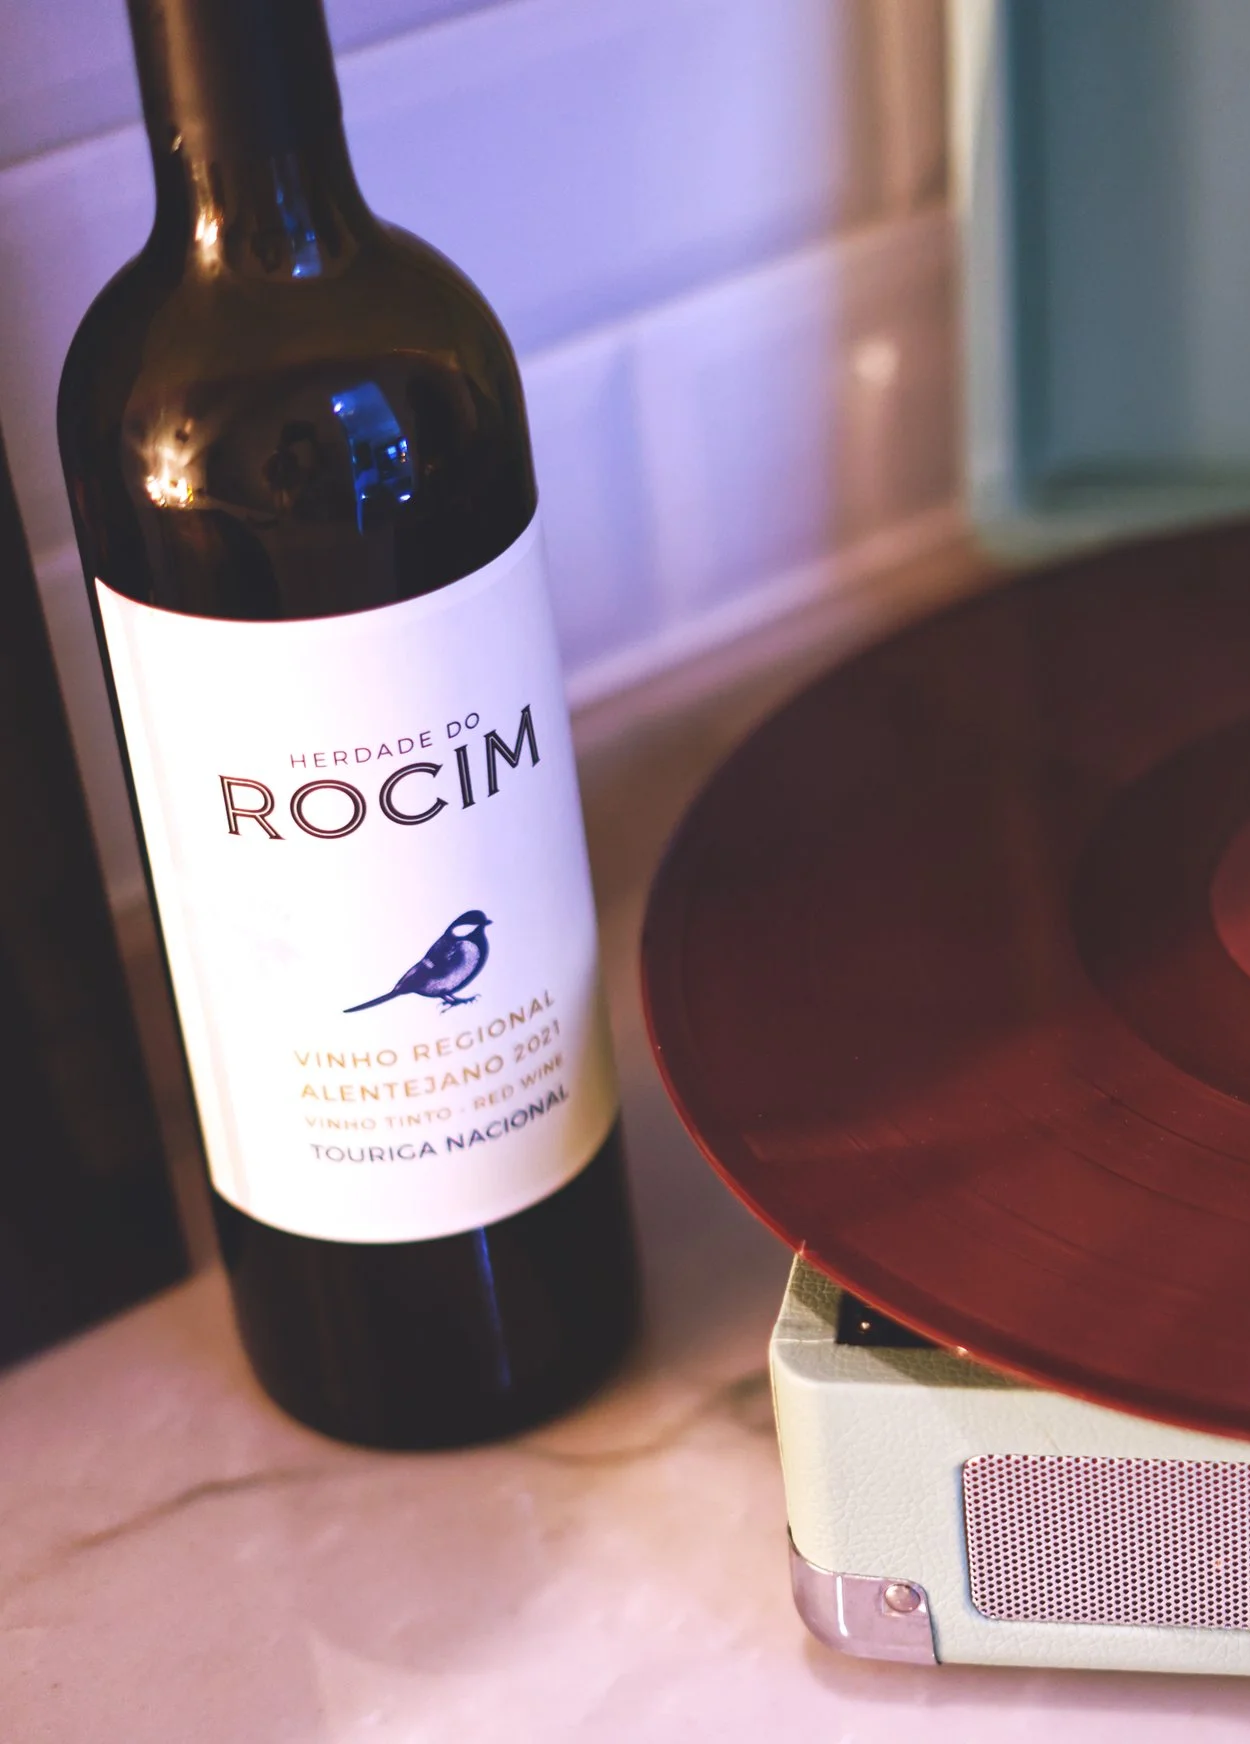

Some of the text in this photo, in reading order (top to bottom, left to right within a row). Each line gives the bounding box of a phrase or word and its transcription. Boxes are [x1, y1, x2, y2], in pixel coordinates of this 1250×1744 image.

[218, 704, 541, 840] ROCIM
[290, 712, 480, 768] HERDADE DO
[293, 990, 555, 1069] VINHO REGIONAL
[301, 1020, 561, 1102] ALENTEJANO 2021
[304, 1115, 377, 1132] VINHO
[386, 1107, 452, 1129] TINTO
[473, 1085, 514, 1111] RED
[520, 1053, 564, 1089] WINE
[309, 1084, 570, 1163] TOURIGA NACIONAL
